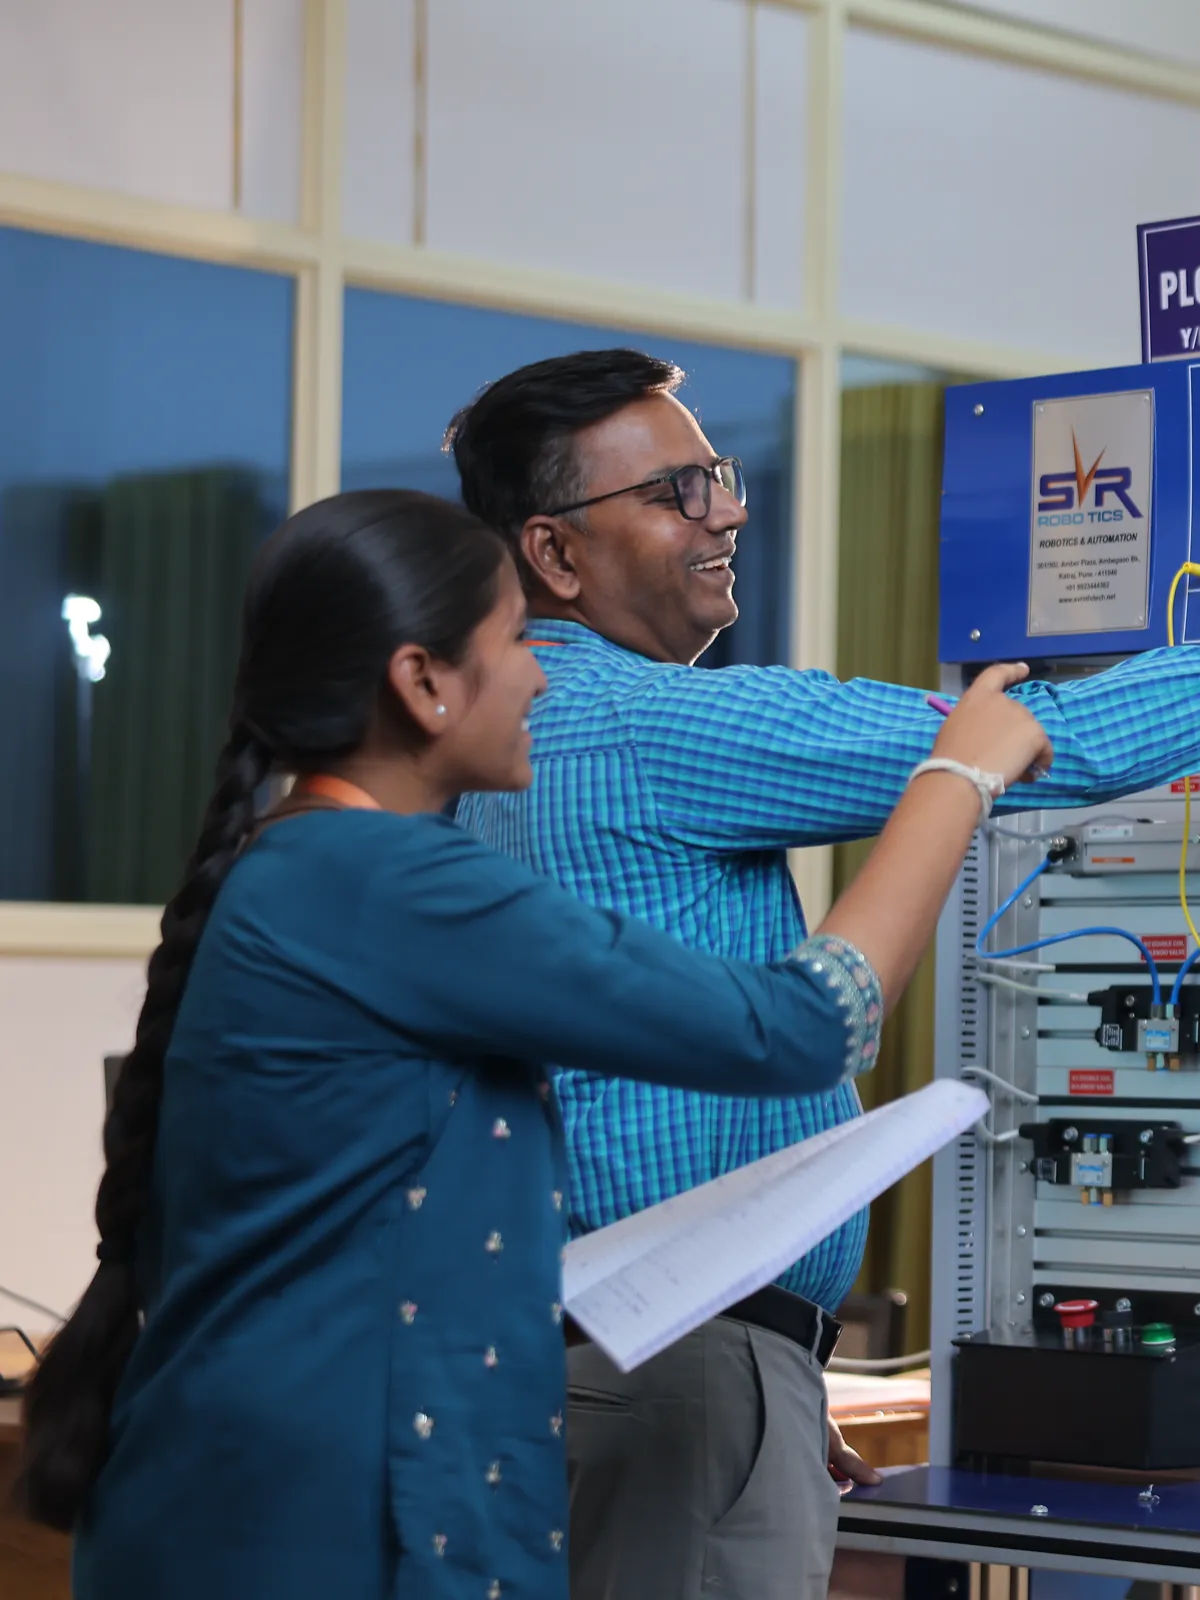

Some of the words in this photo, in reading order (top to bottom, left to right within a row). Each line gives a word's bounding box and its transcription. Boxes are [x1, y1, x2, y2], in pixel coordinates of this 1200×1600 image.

[1040, 537, 1078, 549] ROBOTICS
[1079, 536, 1086, 546] &
[1087, 533, 1138, 545] AUTOMATION
